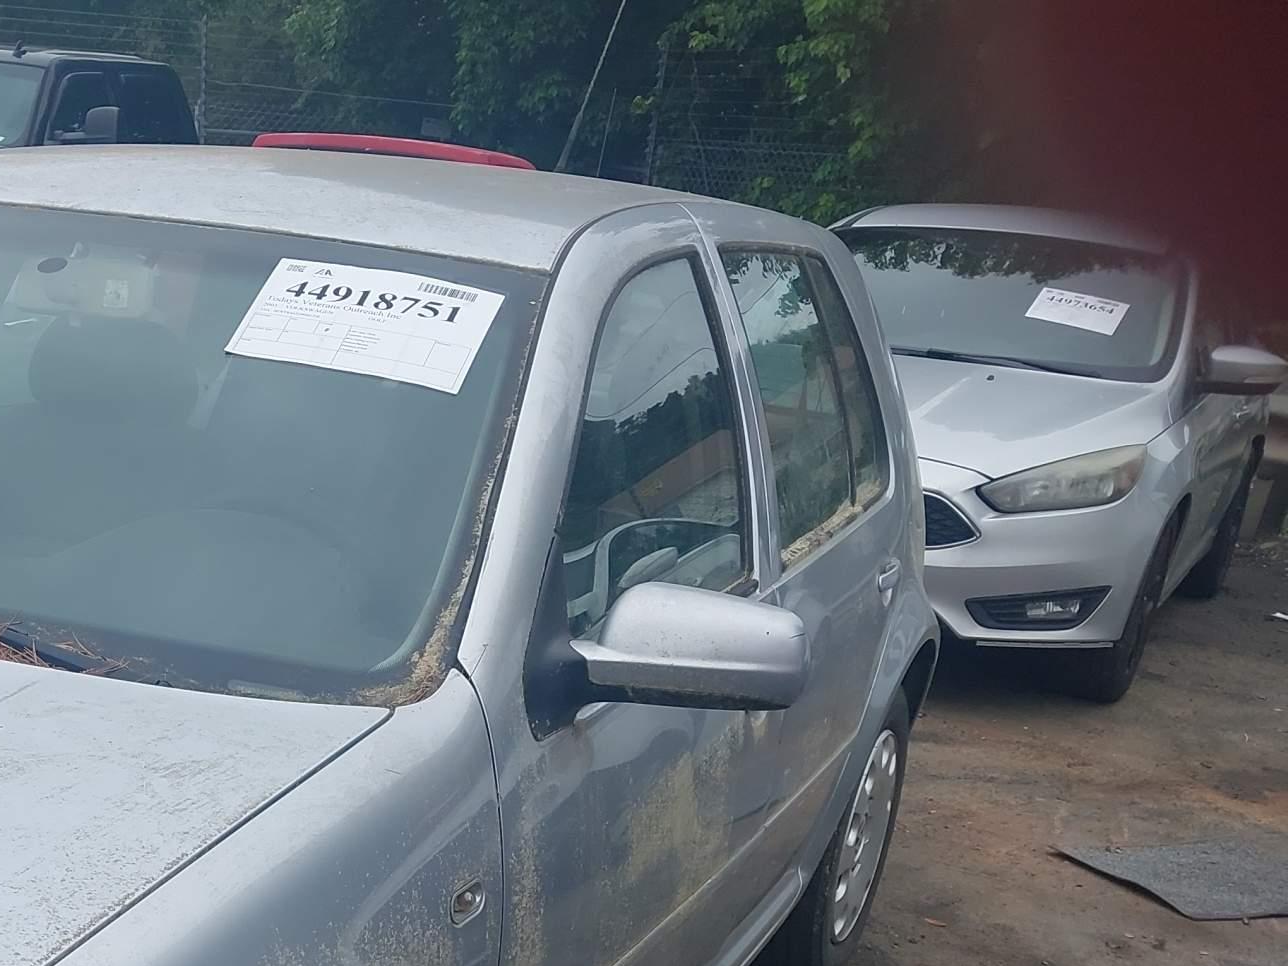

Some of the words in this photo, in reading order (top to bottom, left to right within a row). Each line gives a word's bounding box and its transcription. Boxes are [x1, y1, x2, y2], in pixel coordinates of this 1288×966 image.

[286, 281, 463, 323] 44918751
[303, 299, 341, 310] Veterans
[343, 305, 385, 317] Outreach
[386, 311, 402, 320] Inc
